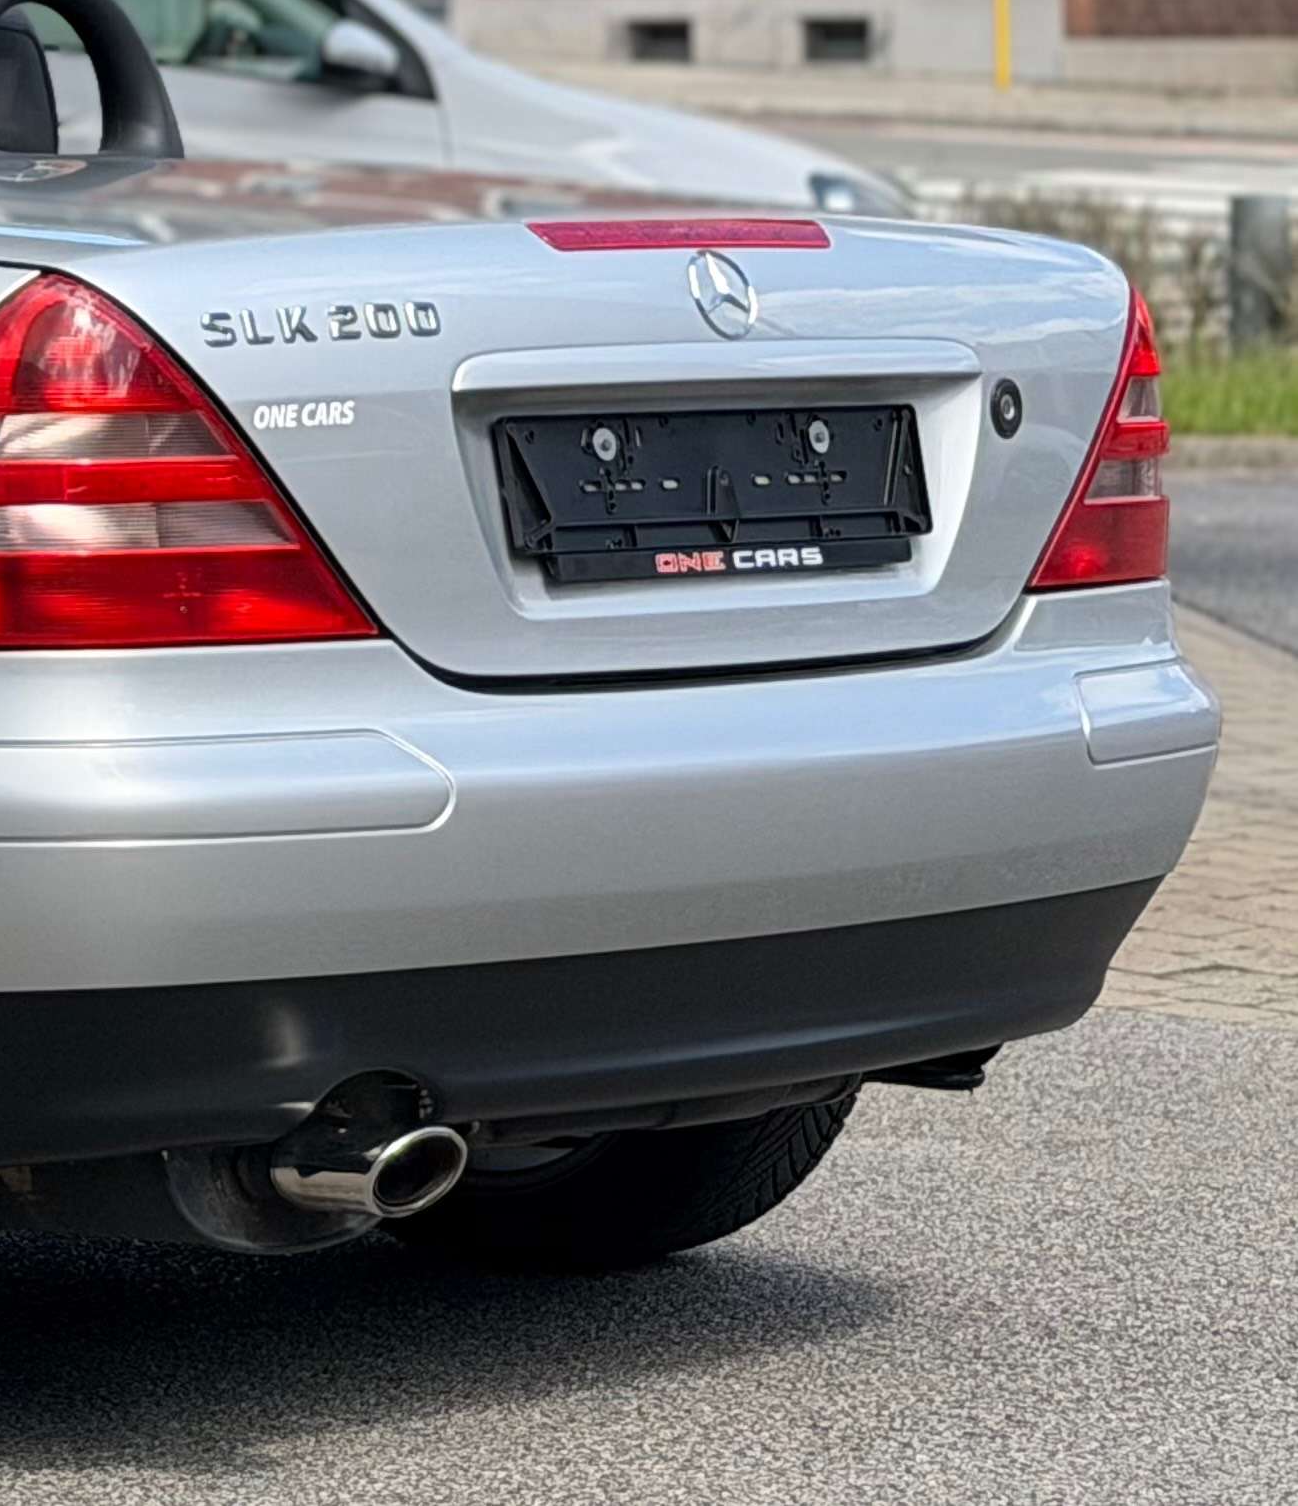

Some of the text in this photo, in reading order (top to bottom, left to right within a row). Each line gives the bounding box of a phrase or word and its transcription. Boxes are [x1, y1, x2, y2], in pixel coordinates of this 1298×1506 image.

[200, 301, 442, 347] SLK 200
[254, 400, 355, 430] ONE CARS
[655, 546, 824, 573] ONE CARS
